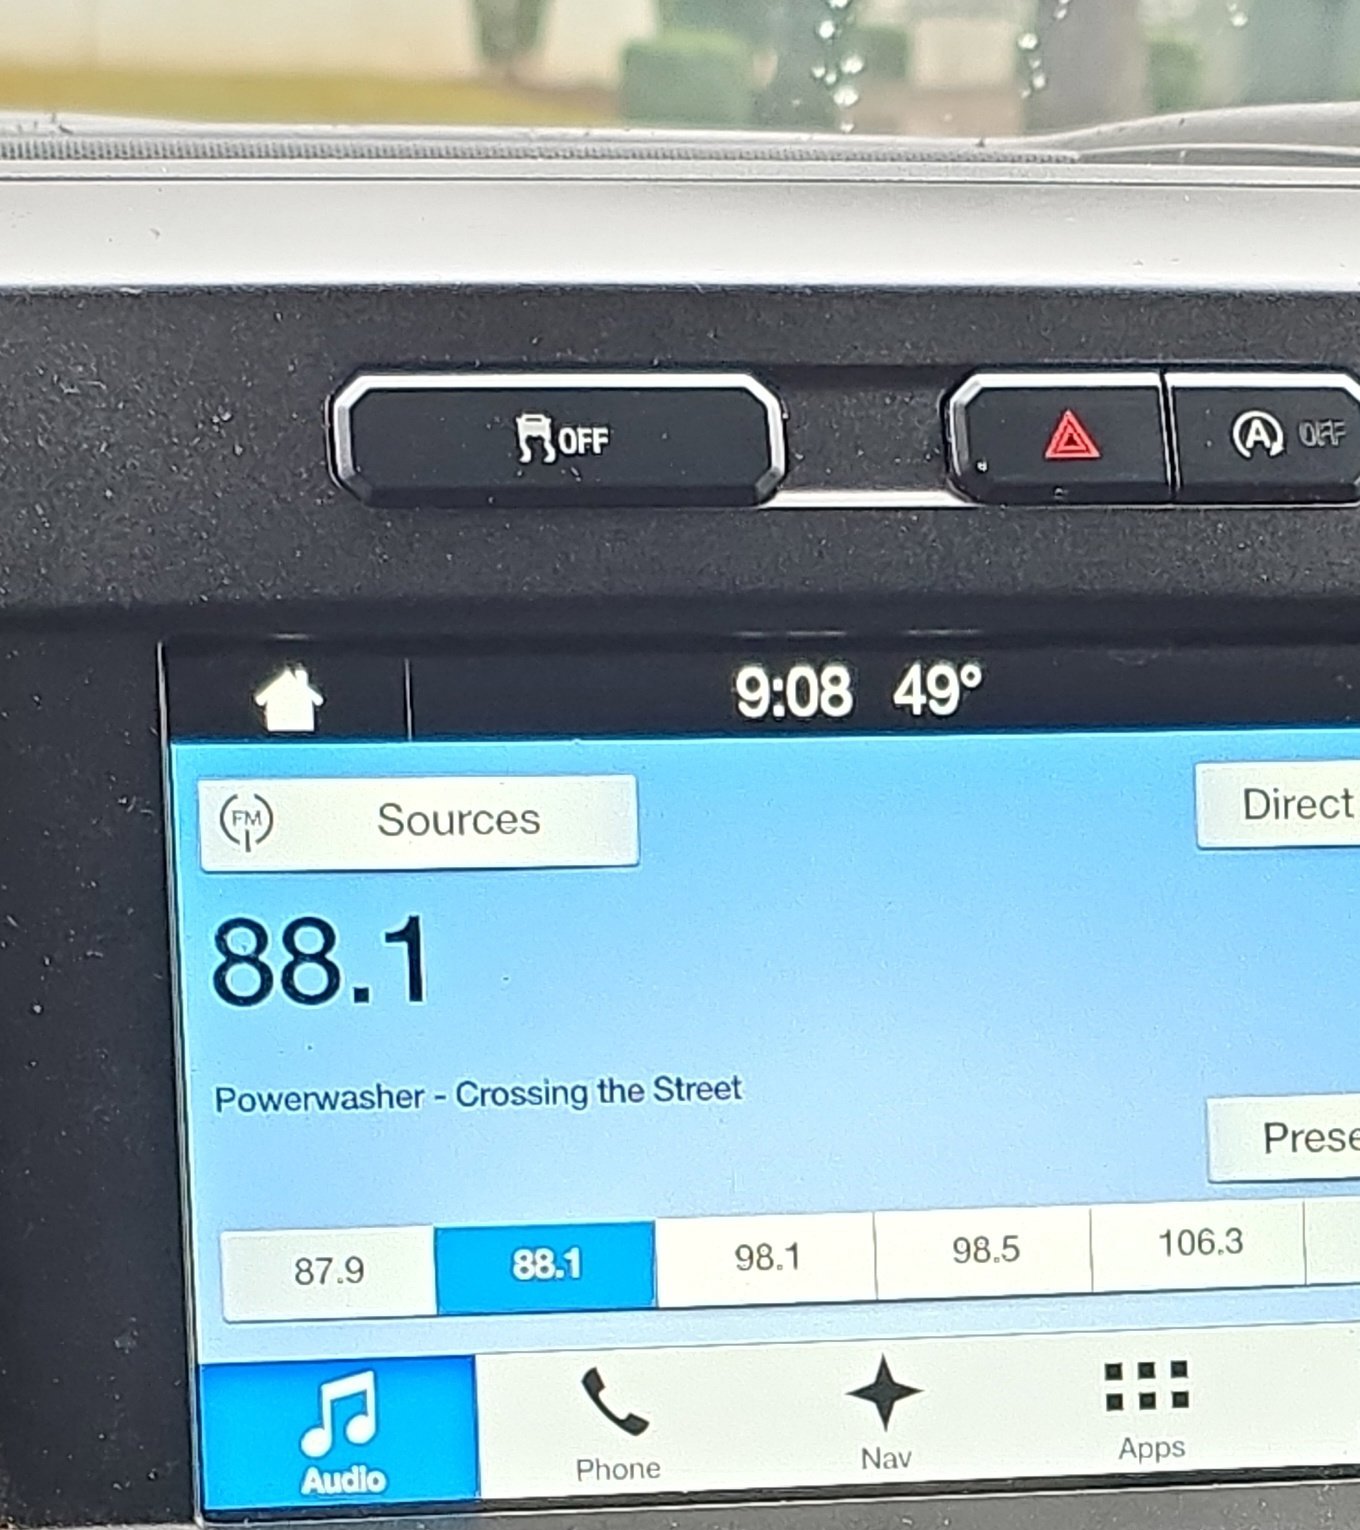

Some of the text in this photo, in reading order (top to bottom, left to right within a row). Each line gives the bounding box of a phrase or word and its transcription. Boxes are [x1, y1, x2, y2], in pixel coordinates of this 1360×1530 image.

[558, 426, 609, 454] OFF
[1298, 419, 1347, 447] OFF
[735, 663, 853, 718] 9:08
[232, 810, 262, 826] FM
[1244, 787, 1355, 820] Direct
[378, 802, 541, 837] Sources
[212, 915, 423, 1007] 88.1
[215, 1083, 425, 1113] Powerwasher
[456, 1078, 588, 1111] Crossing
[596, 1077, 645, 1104] the
[653, 1075, 742, 1102] Street
[734, 1242, 798, 1271] 98.1
[953, 1234, 1020, 1264] 98.5
[1159, 1227, 1244, 1257] 106.3
[294, 1255, 364, 1286] 87.9
[513, 1247, 580, 1280] 88.1
[861, 1446, 912, 1470] Nav
[1118, 1437, 1186, 1464] Apps
[300, 1464, 387, 1495] Audio
[576, 1458, 661, 1482] Phone
